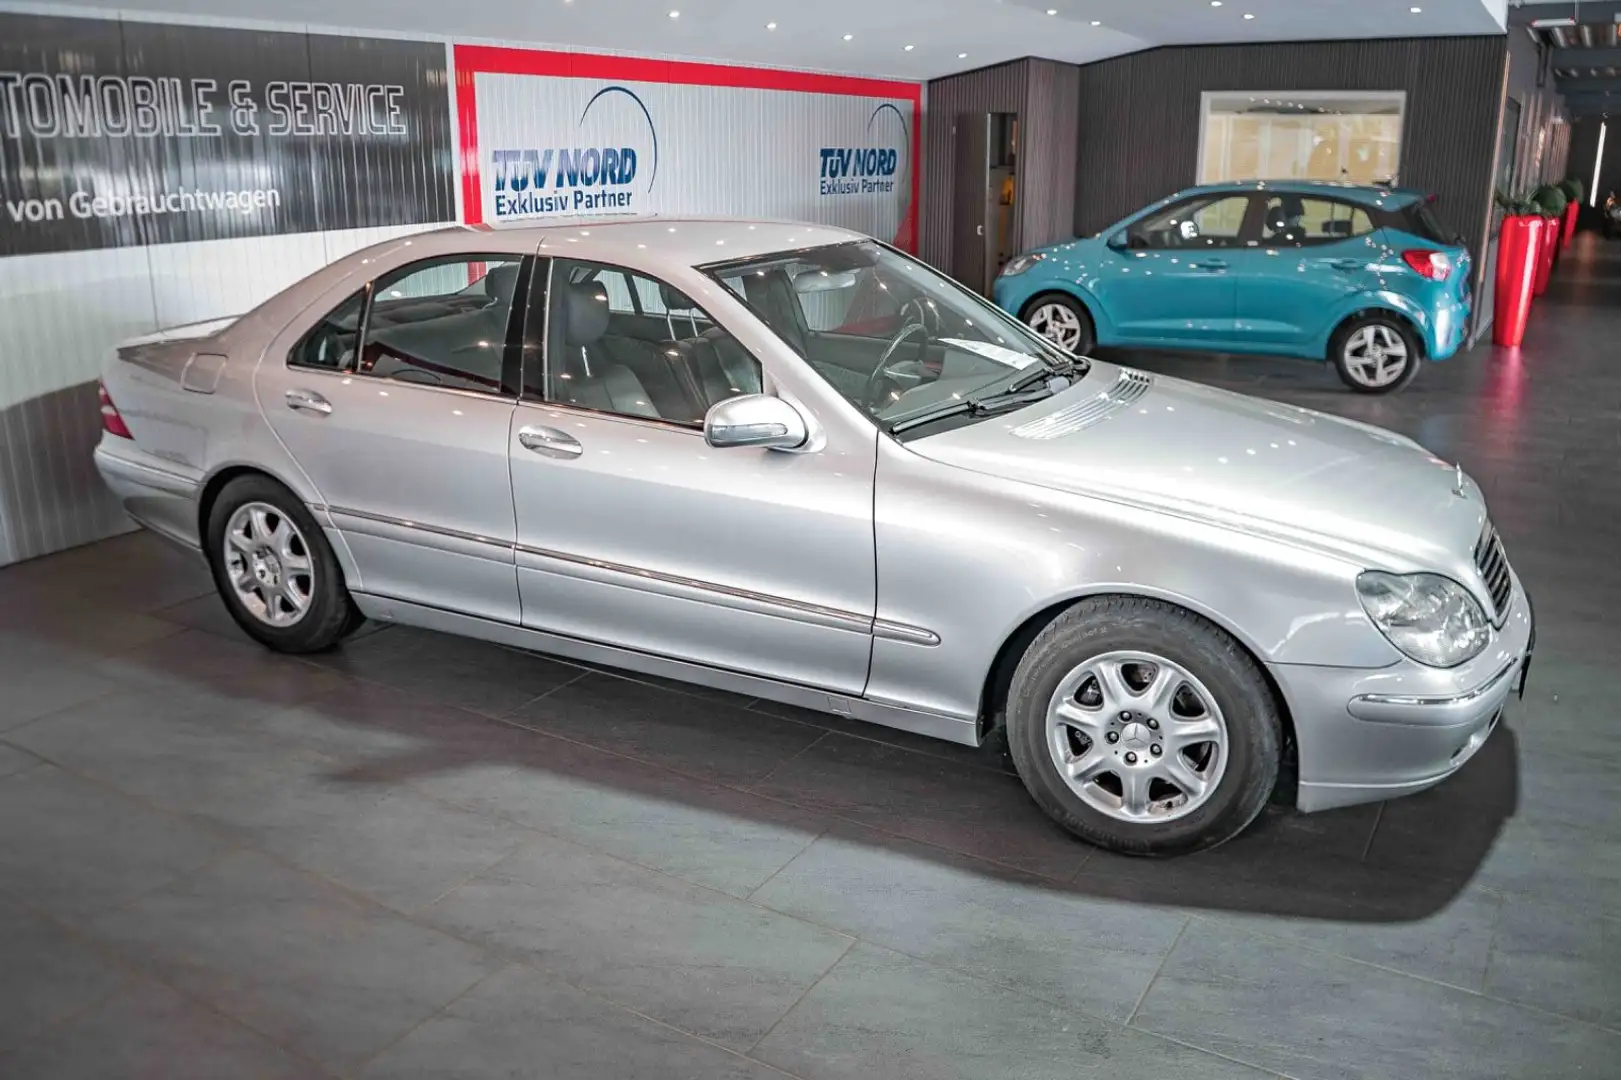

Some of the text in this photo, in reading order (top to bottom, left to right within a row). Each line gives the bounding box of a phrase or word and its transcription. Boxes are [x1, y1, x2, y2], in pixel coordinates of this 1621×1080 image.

[228, 80, 260, 137] &
[266, 81, 407, 136] SERVICE
[555, 147, 637, 188] NORD
[852, 148, 897, 177] NORD
[495, 189, 632, 216] Exklusiv Partner
[820, 178, 894, 195] Exklusiv Partner
[6, 186, 281, 222] von Gebrauchtwagen
